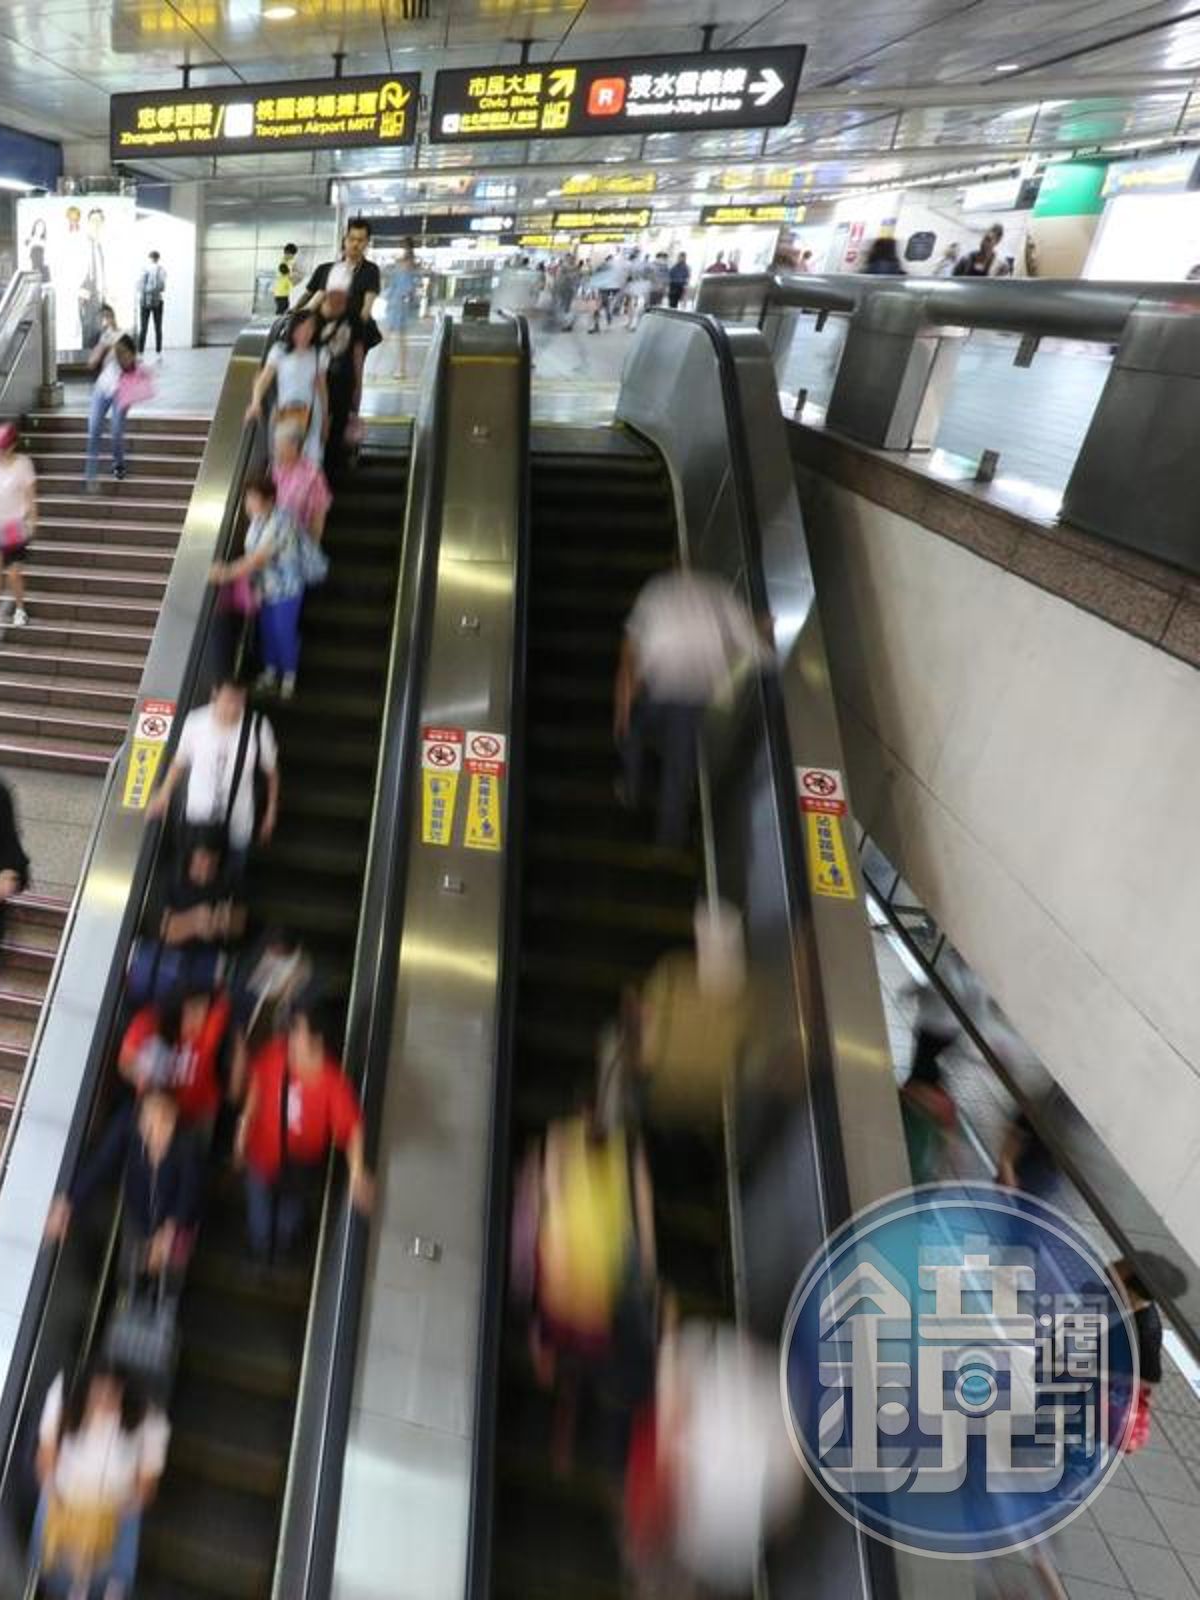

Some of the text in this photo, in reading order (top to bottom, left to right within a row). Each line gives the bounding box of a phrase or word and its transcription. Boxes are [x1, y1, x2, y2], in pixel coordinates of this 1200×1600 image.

[598, 88, 613, 106] R
[304, 120, 345, 134] Airport
[348, 117, 377, 131] MRT
